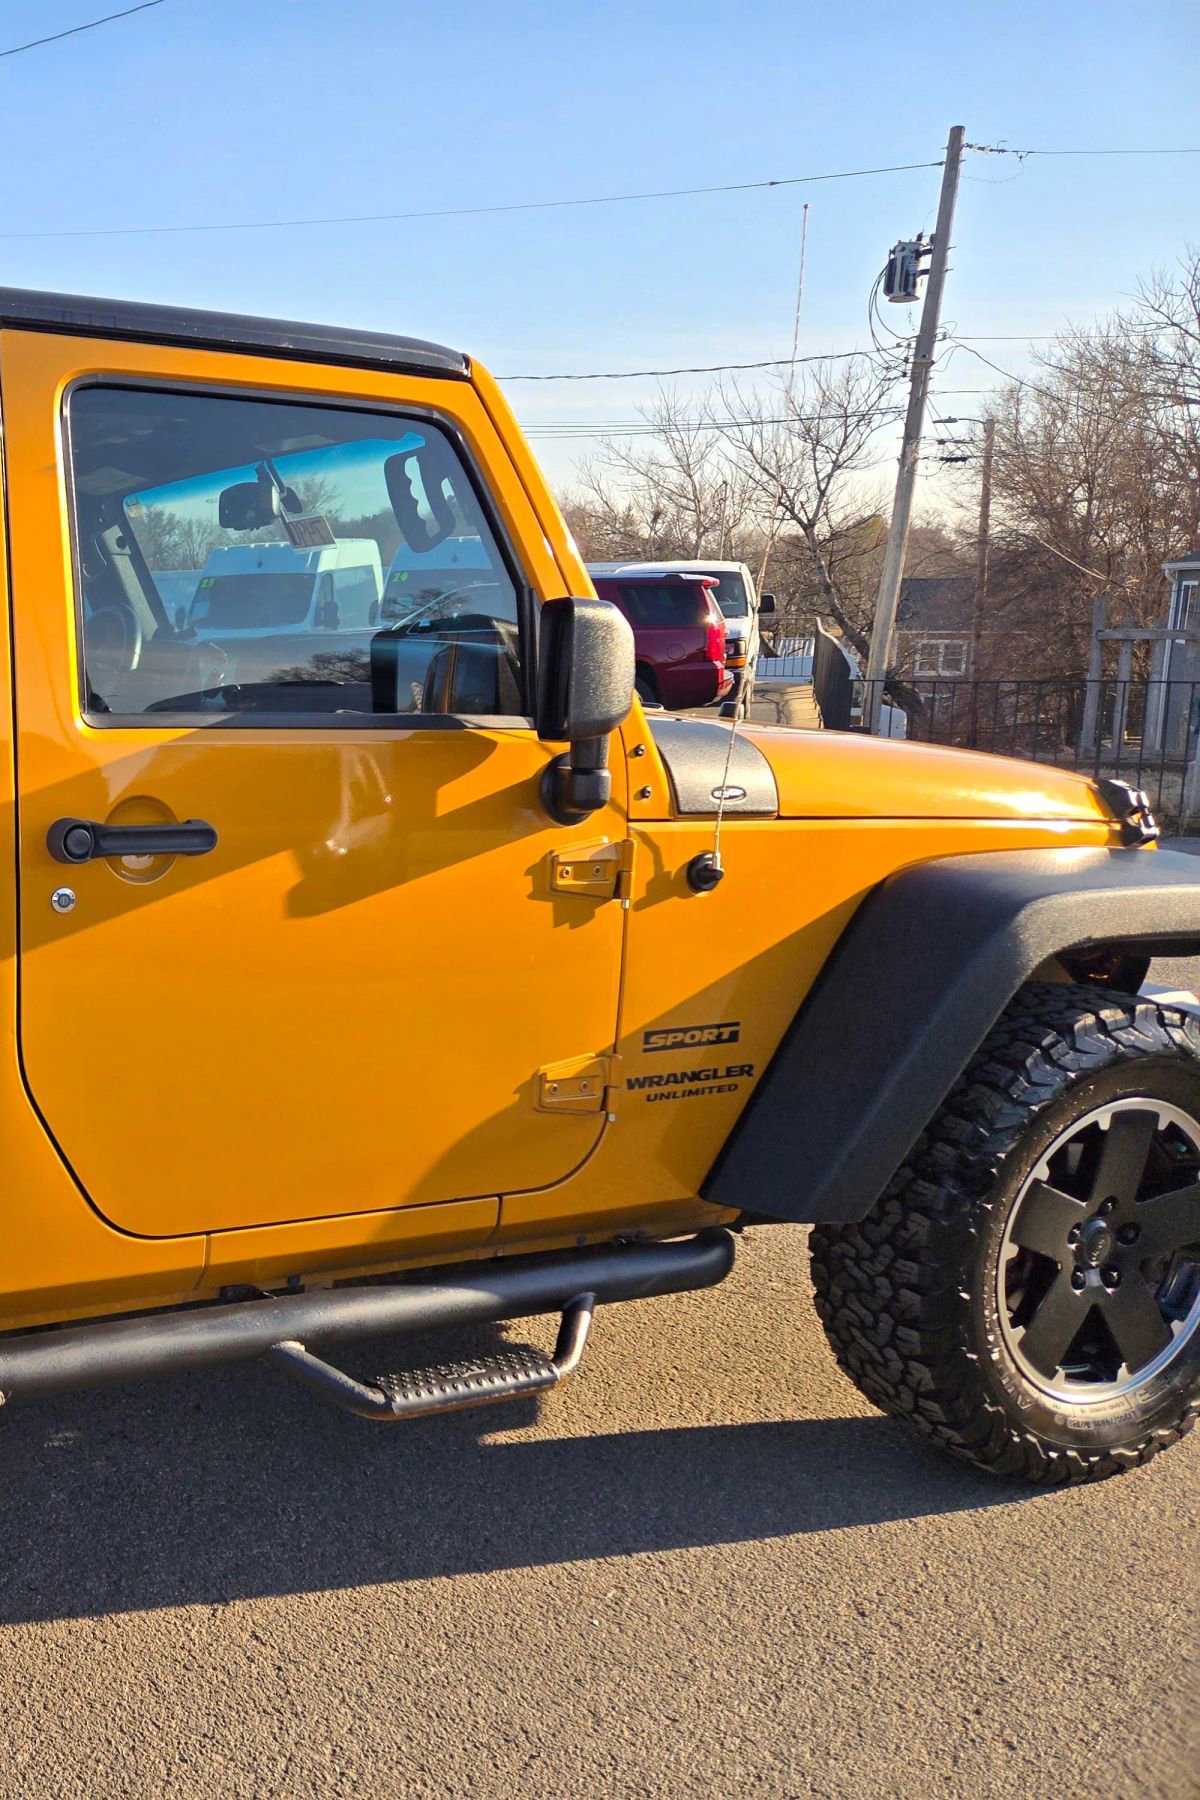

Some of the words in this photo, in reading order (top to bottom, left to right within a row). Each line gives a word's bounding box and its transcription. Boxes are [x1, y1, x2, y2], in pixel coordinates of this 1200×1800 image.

[645, 1025, 739, 1049] SPORT
[626, 1064, 754, 1090] WRANGLER
[646, 1083, 738, 1102] UNLIMITED
